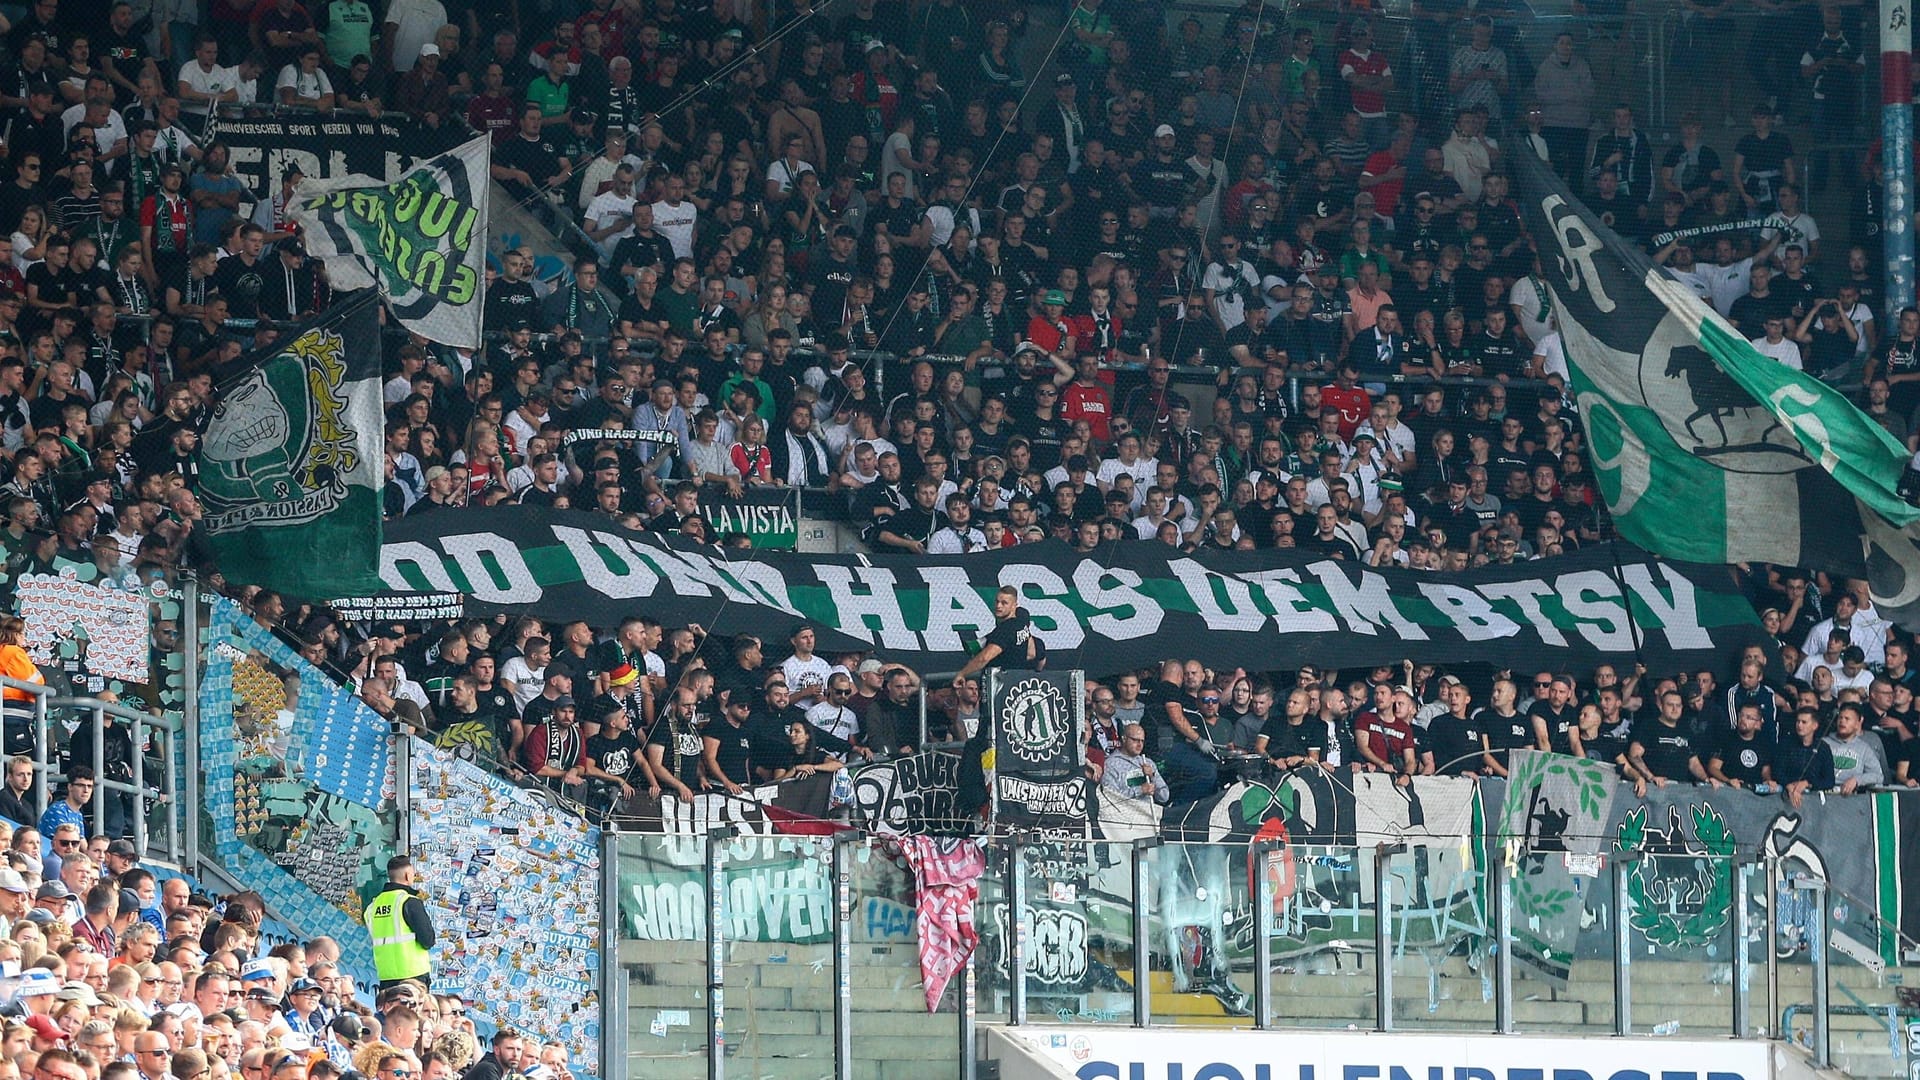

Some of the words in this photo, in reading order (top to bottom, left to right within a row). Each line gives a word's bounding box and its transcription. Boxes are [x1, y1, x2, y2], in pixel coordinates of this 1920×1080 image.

[216, 122, 284, 136] ANNOVERSCHER
[289, 124, 317, 136] SPORT
[322, 123, 351, 135] VEREIN
[357, 123, 374, 136] VON
[577, 428, 603, 441] UND
[604, 428, 636, 440] HASS
[639, 429, 665, 442] DEM
[735, 503, 796, 535] VISTA
[378, 531, 544, 605] OD
[549, 524, 808, 620] UND
[810, 556, 1166, 653] HASS
[1166, 556, 1431, 641] DEM
[1416, 561, 1716, 652] BTSV
[405, 595, 429, 608] DEM
[430, 594, 458, 607] BTSV
[385, 607, 414, 621] HASS
[414, 607, 437, 620] DEM
[437, 605, 464, 619] BTSV
[660, 784, 779, 866] WEST
[374, 904, 392, 916] ABS
[542, 931, 591, 950] SUPTRA
